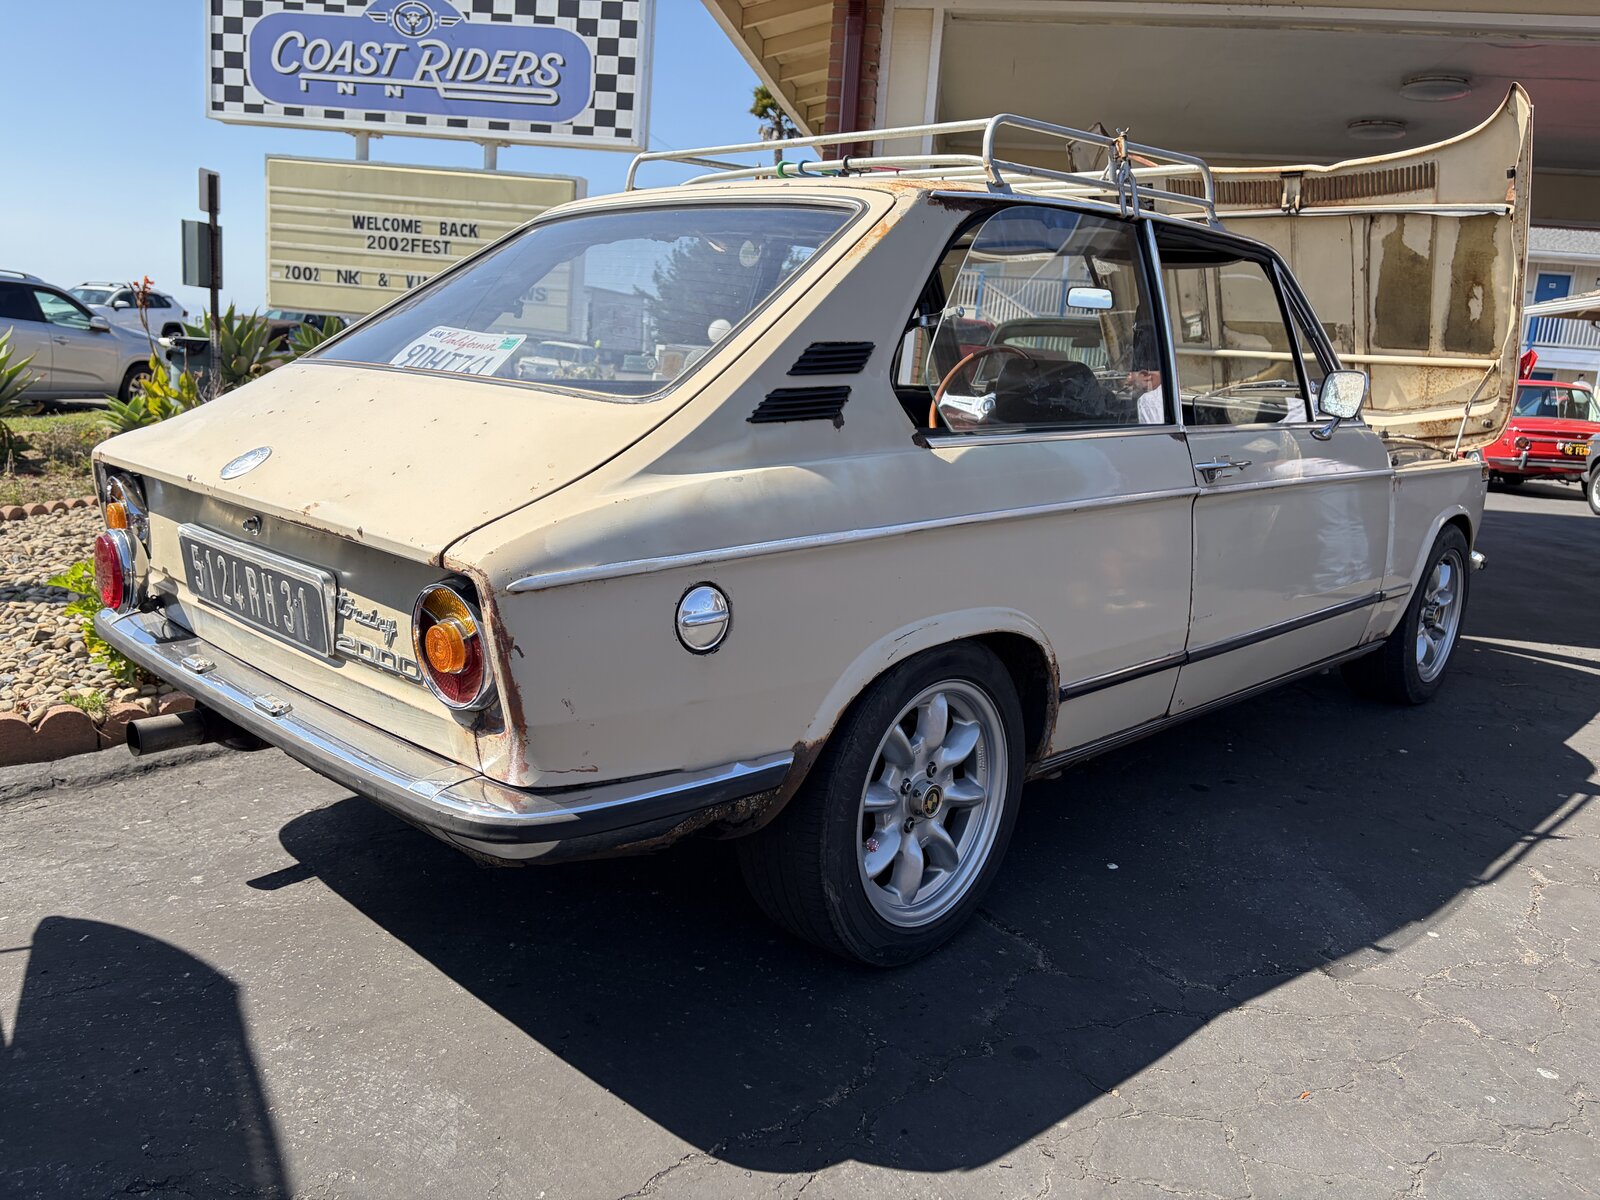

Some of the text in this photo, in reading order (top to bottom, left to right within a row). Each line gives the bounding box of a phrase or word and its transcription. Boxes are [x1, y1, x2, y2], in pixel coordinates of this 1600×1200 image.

[270, 30, 565, 97] COAST RIDERS
[299, 80, 405, 98] INN
[352, 215, 480, 239] WELCOME BACK
[366, 234, 452, 256] 2002FEST
[284, 265, 321, 283] 2002
[336, 269, 361, 286] NK
[377, 273, 389, 288] &
[335, 632, 424, 686] 2000
